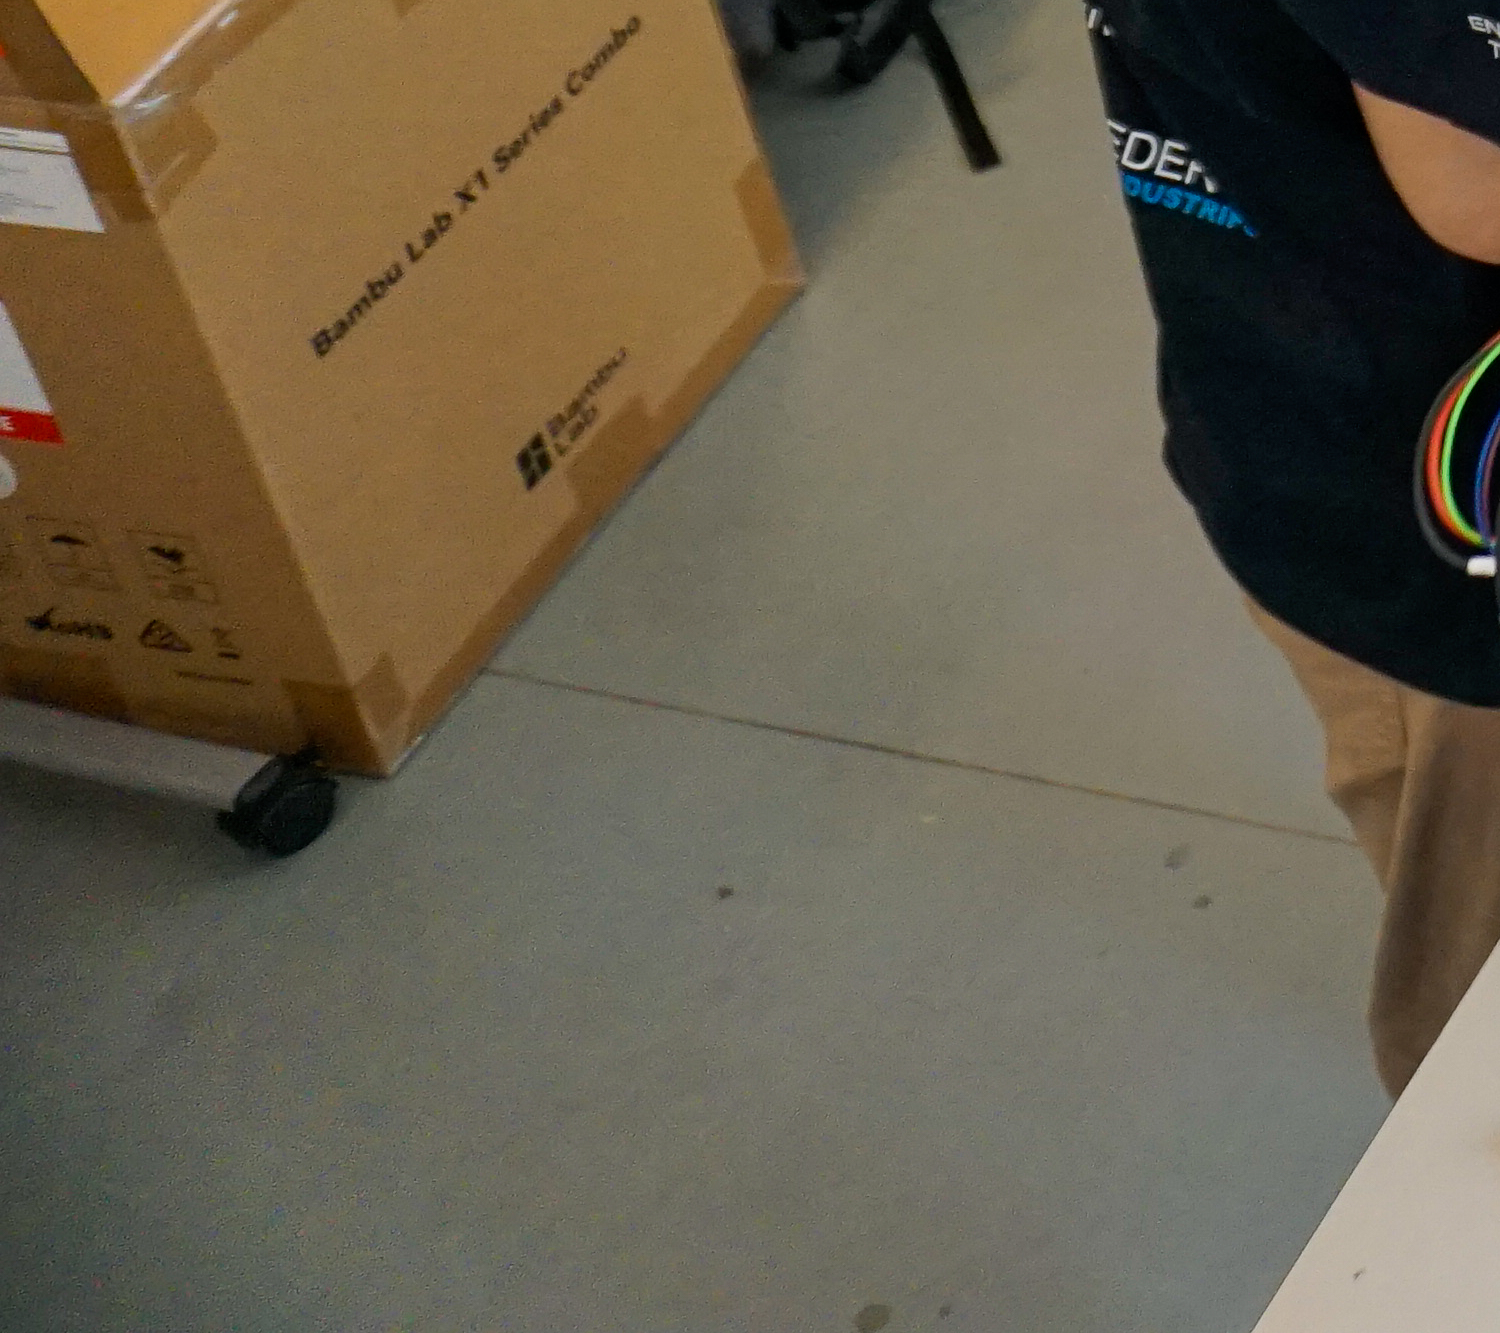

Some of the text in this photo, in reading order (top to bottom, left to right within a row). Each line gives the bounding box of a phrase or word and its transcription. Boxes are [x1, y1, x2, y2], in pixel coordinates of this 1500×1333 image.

[309, 15, 642, 359] Bambu Lab X1 Series Combo
